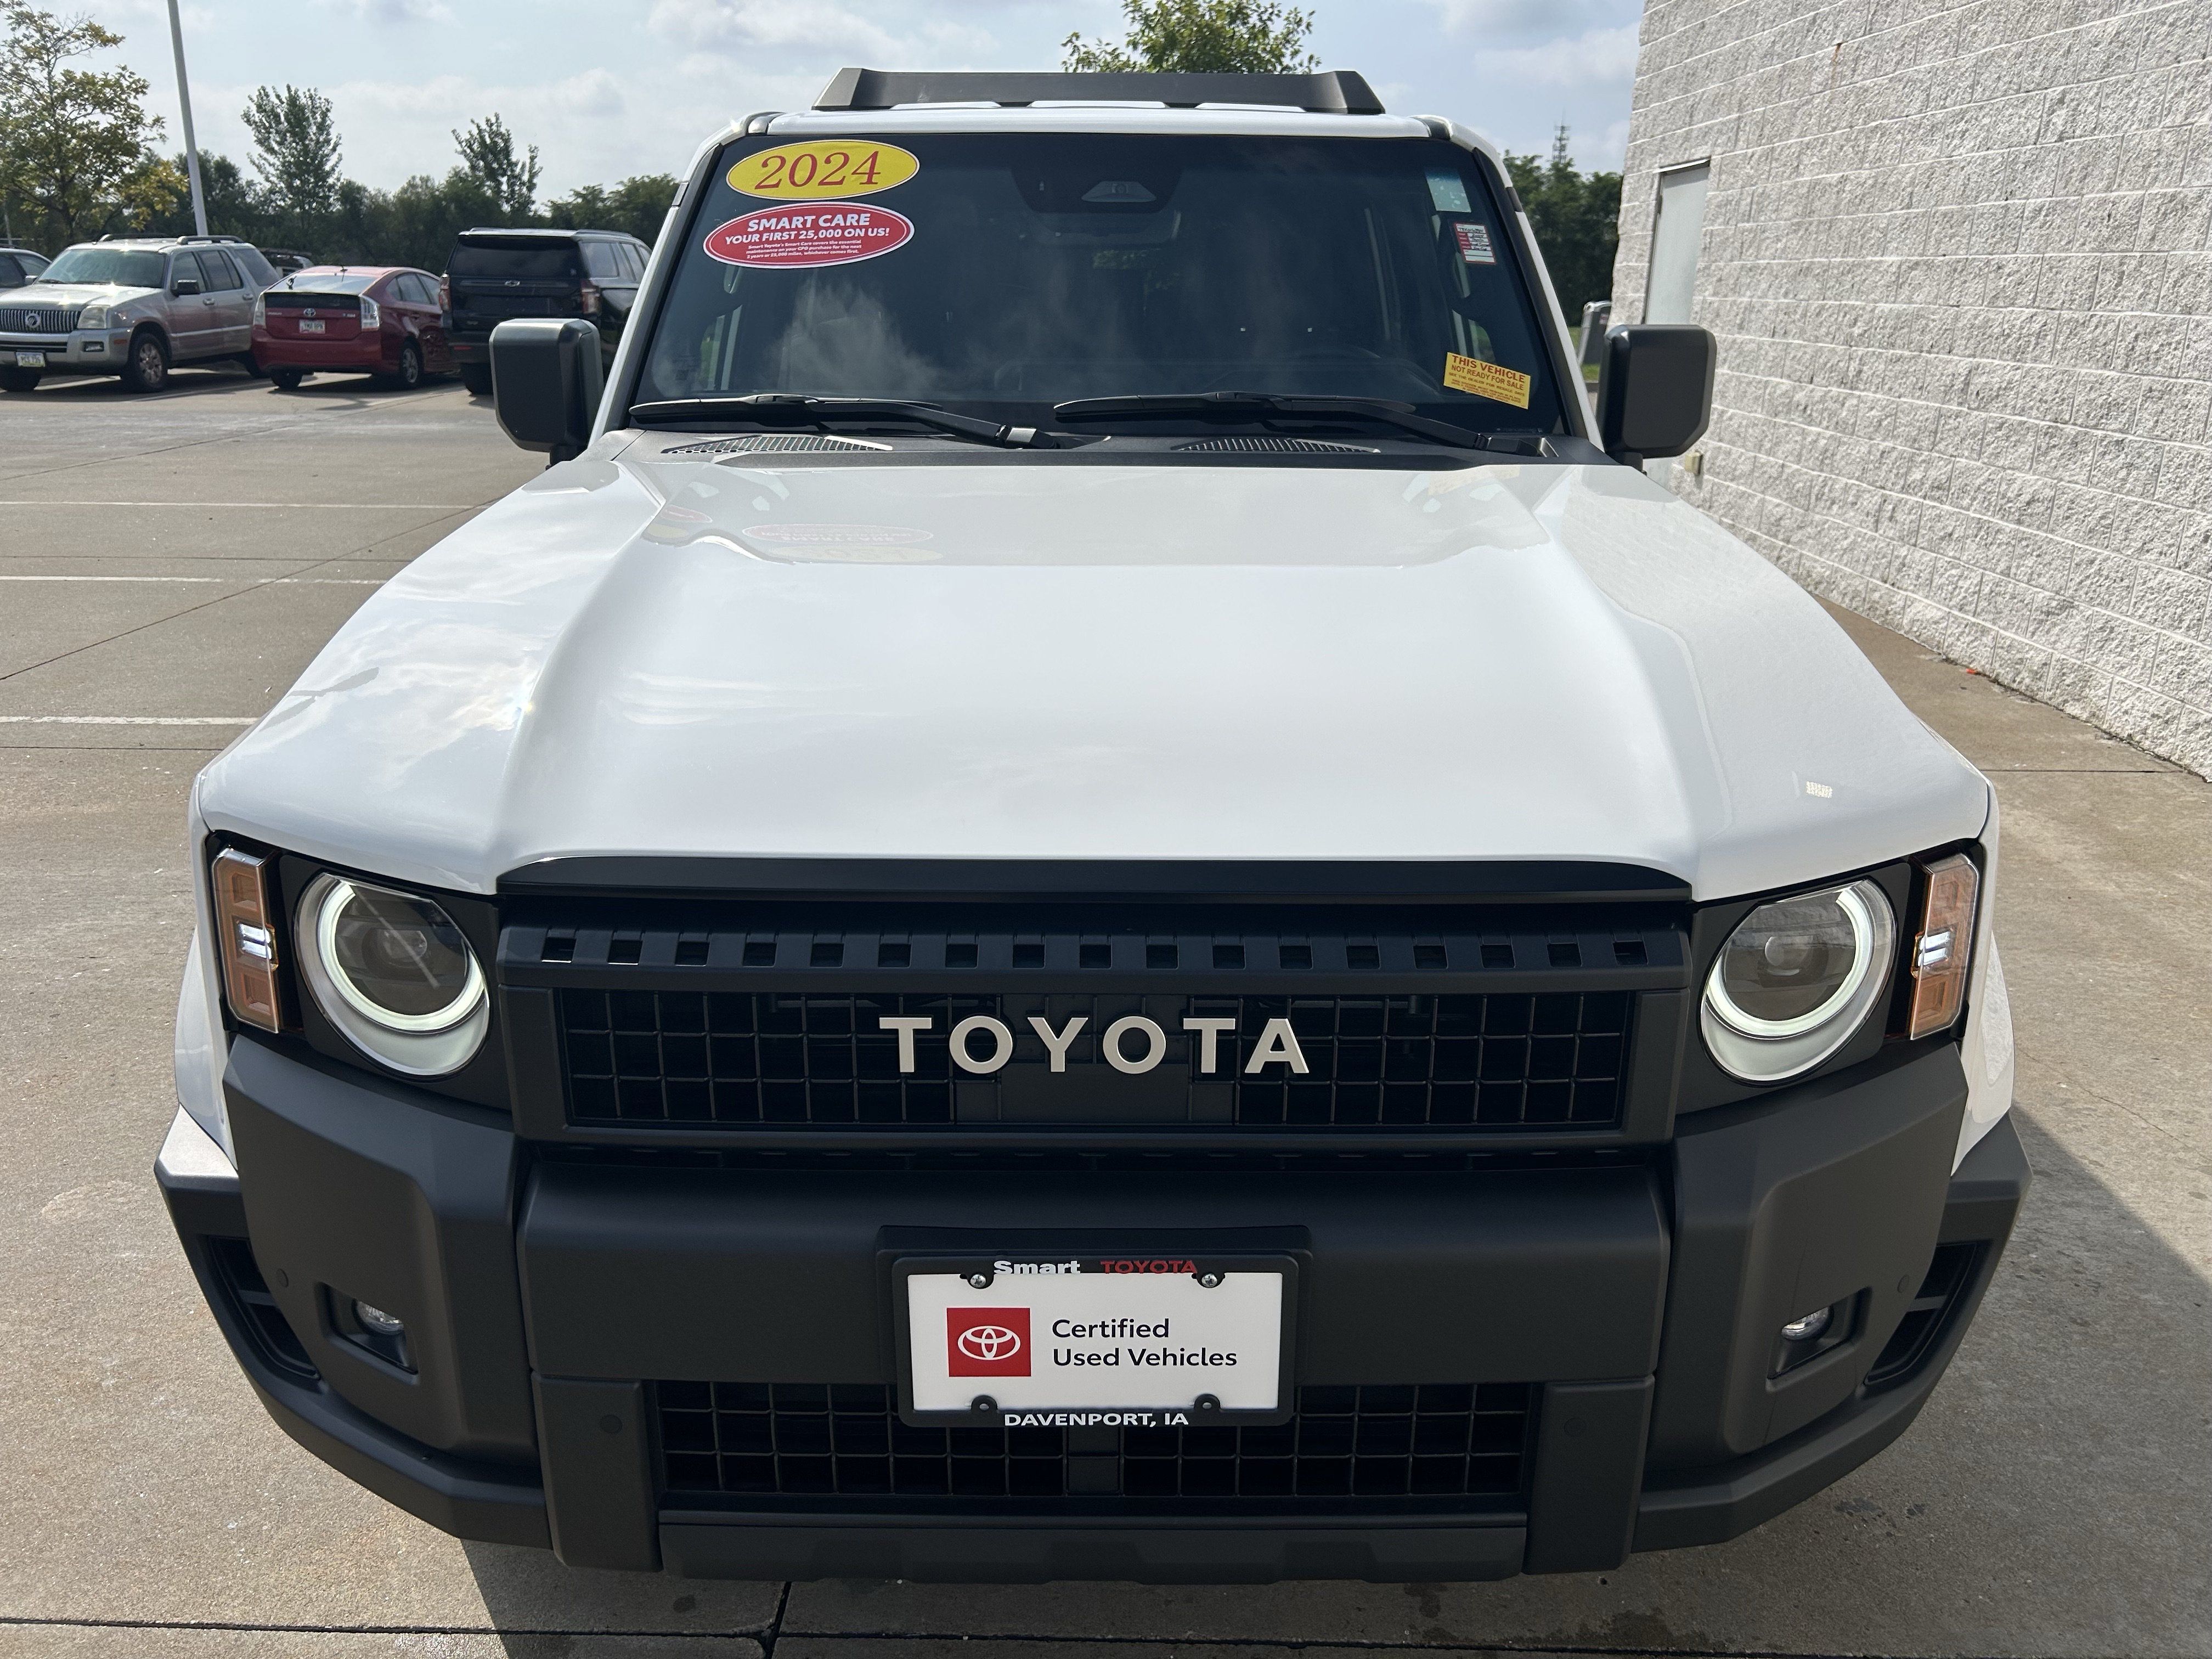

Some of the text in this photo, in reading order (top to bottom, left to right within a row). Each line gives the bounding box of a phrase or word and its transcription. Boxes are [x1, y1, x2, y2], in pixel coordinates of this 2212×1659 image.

[754, 151, 881, 189] 2024
[747, 213, 871, 232] SMART CARE
[725, 228, 890, 245] YOUR FIRST 25,000 ON US!
[1451, 364, 1523, 390] NOT READY FOR SALE
[1452, 355, 1526, 383] THIS VEHICLE
[879, 1015, 1309, 1074] TOYOTA
[994, 1260, 1199, 1274] Smart TOYOTA
[1052, 1318, 1170, 1339] Certified
[1052, 1347, 1238, 1367] Used Vehicles
[1004, 1413, 1189, 1427] DAVENPORT, IA
